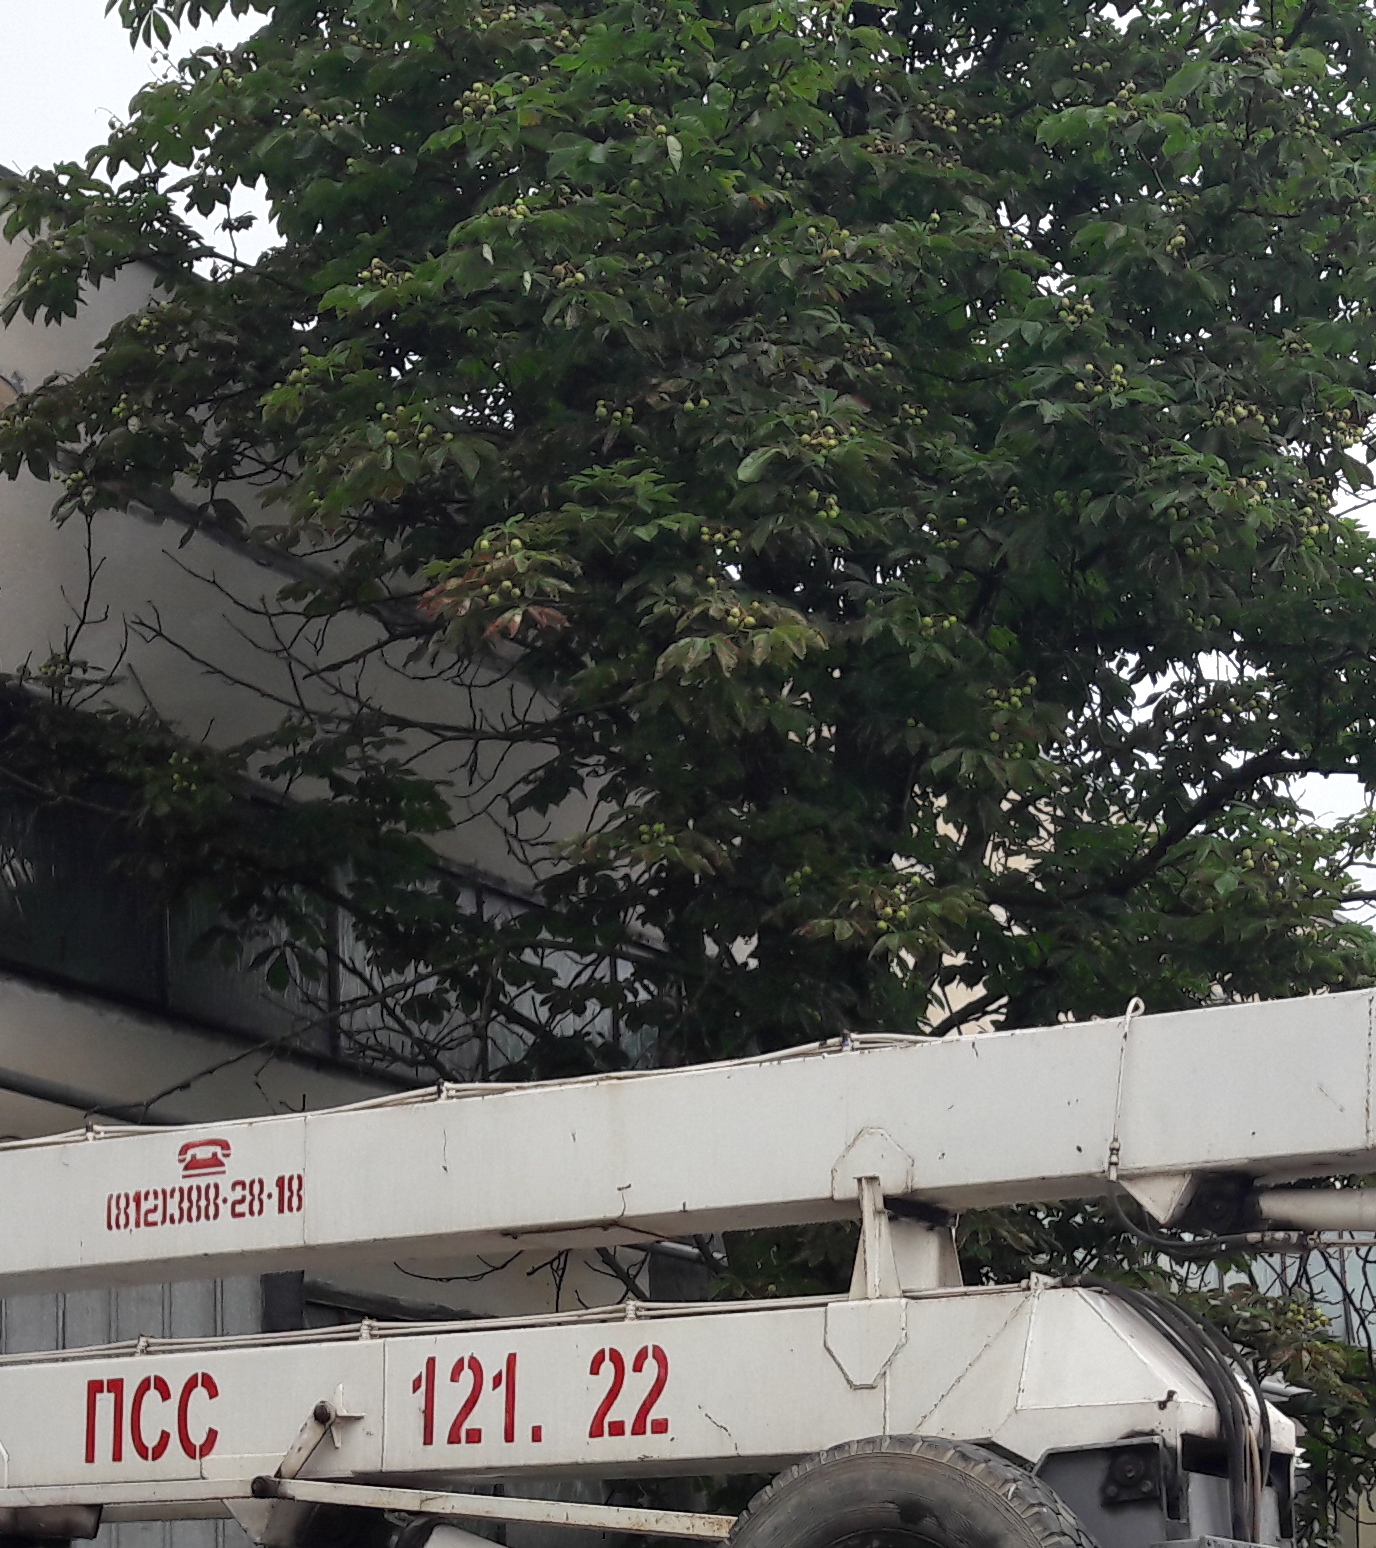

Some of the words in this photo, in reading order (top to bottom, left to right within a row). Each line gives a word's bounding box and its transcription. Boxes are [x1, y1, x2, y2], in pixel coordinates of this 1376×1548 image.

[85, 1372, 220, 1464] ПСС
[412, 1352, 543, 1446] 121.
[589, 1344, 669, 1438] 22
